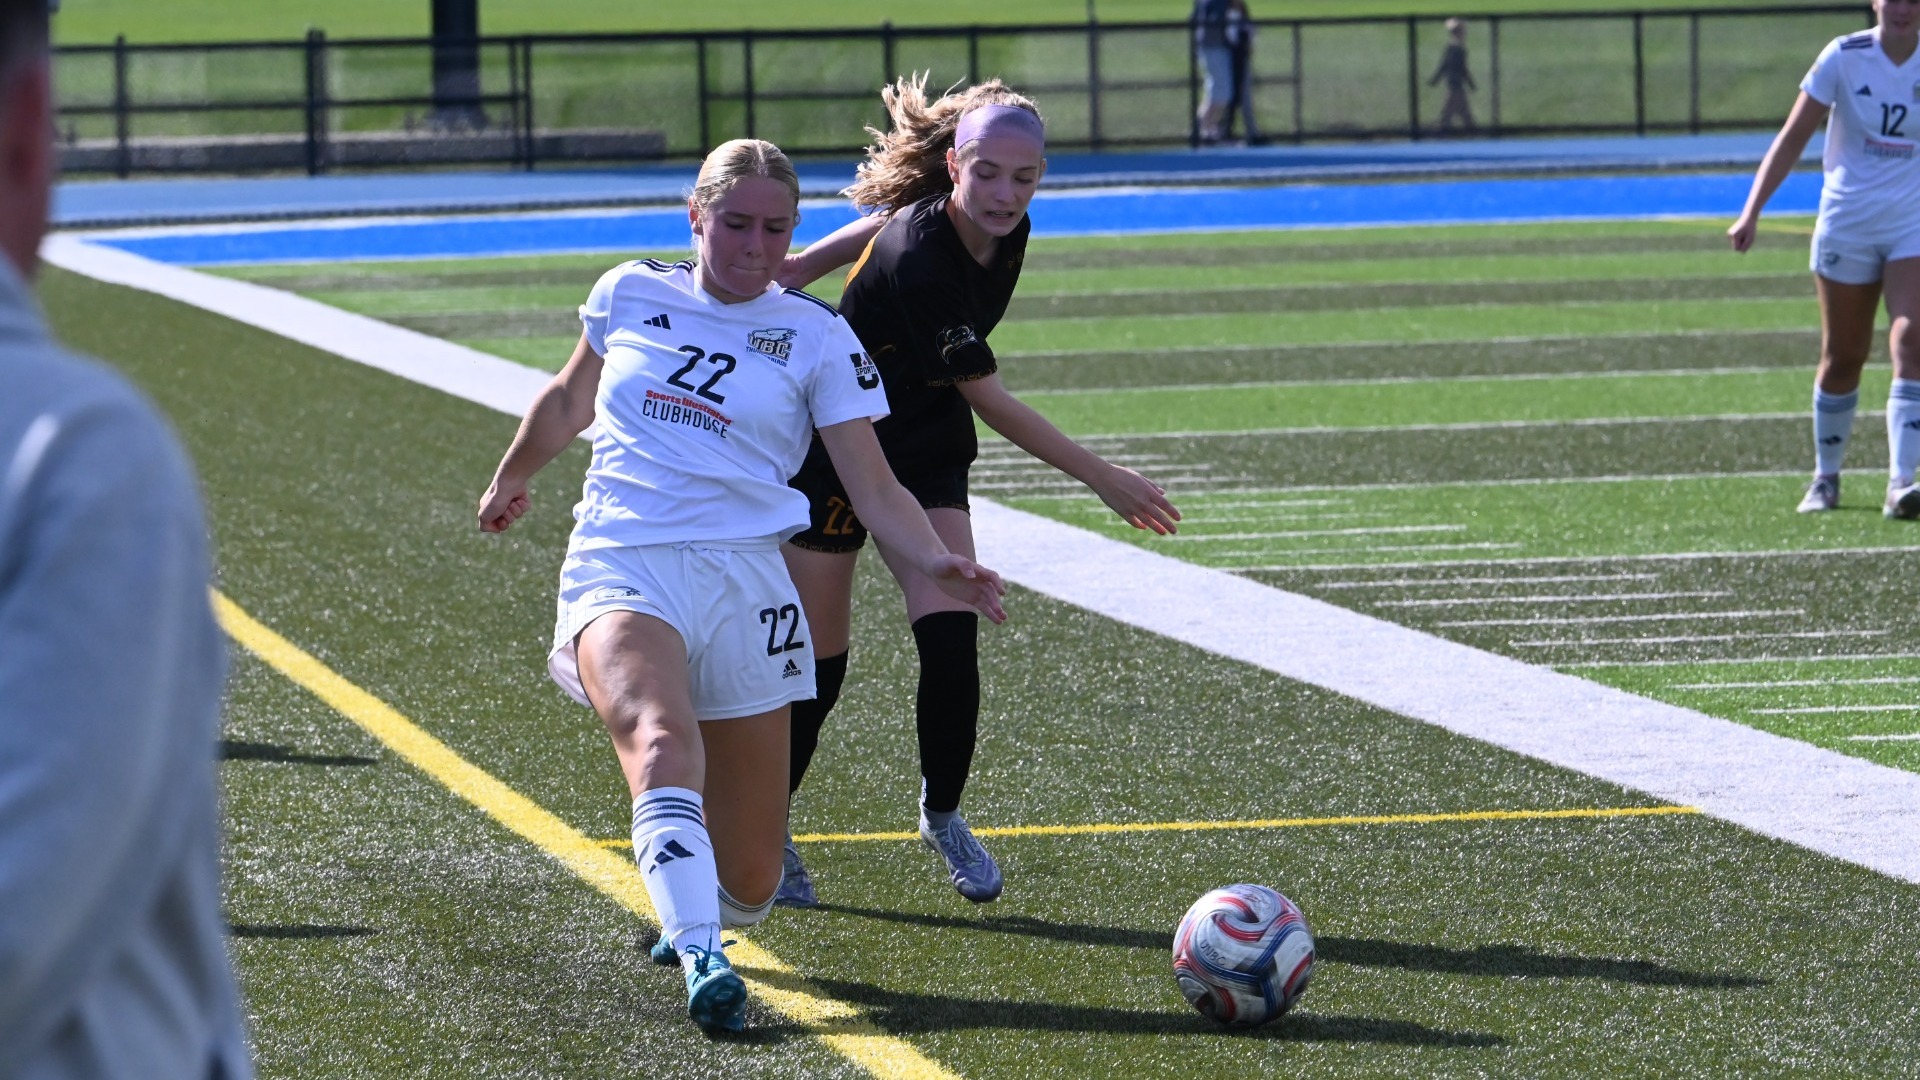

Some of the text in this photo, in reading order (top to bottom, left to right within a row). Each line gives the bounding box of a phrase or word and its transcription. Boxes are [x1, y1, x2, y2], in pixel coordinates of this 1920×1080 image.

[1881, 103, 1907, 137] 12
[748, 335, 792, 361] UBC
[667, 345, 736, 405] 22
[855, 366, 877, 376] SPORTS
[642, 399, 728, 438] CLUBHOUSE
[646, 390, 732, 425] Sports Illustrated
[823, 496, 855, 535] 22
[760, 603, 804, 656] 22
[782, 669, 801, 679] adidas
[1200, 939, 1226, 965] UNBC
